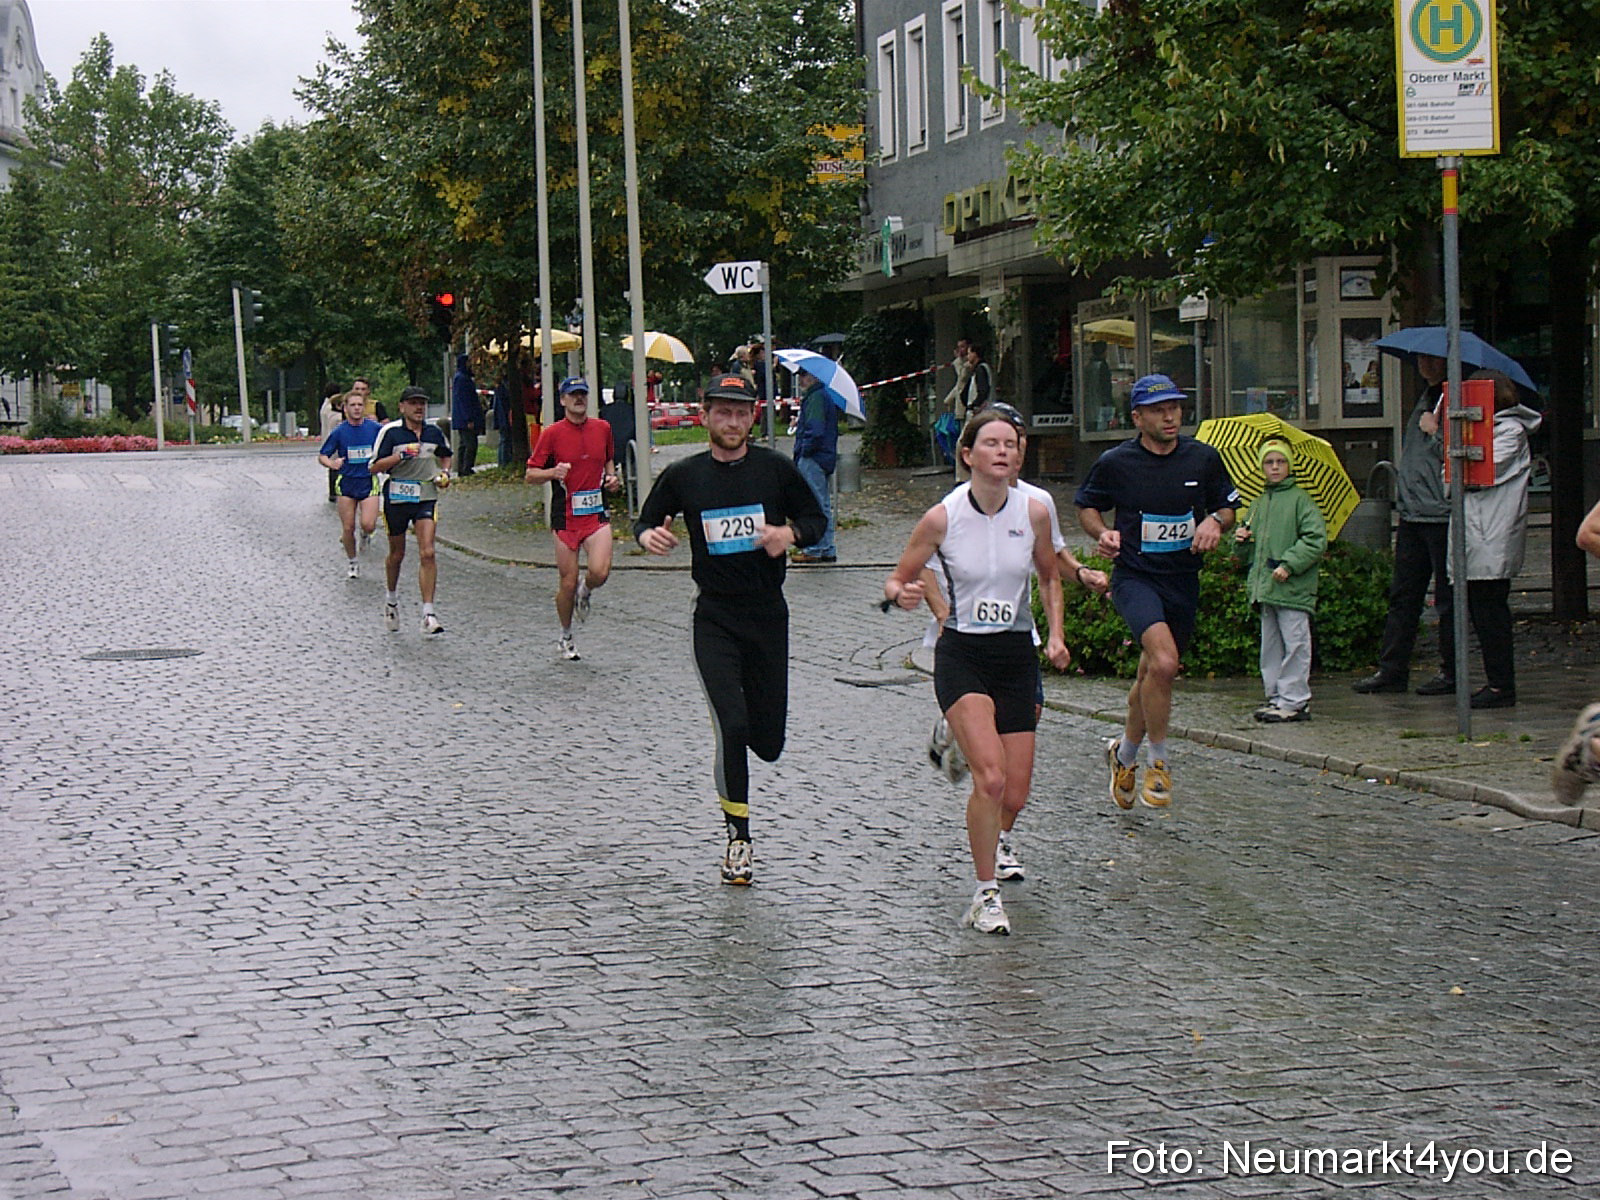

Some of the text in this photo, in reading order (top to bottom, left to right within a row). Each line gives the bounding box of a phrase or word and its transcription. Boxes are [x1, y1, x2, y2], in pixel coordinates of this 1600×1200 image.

[1430, 6, 1463, 45] H
[1409, 71, 1486, 83] Oberer Markt
[944, 172, 1042, 235] OPTIKE
[721, 266, 754, 289] WC
[400, 484, 415, 495] 506
[581, 495, 598, 506] 437
[720, 516, 755, 538] 229
[1157, 523, 1188, 540] 242
[977, 602, 1012, 622] 636
